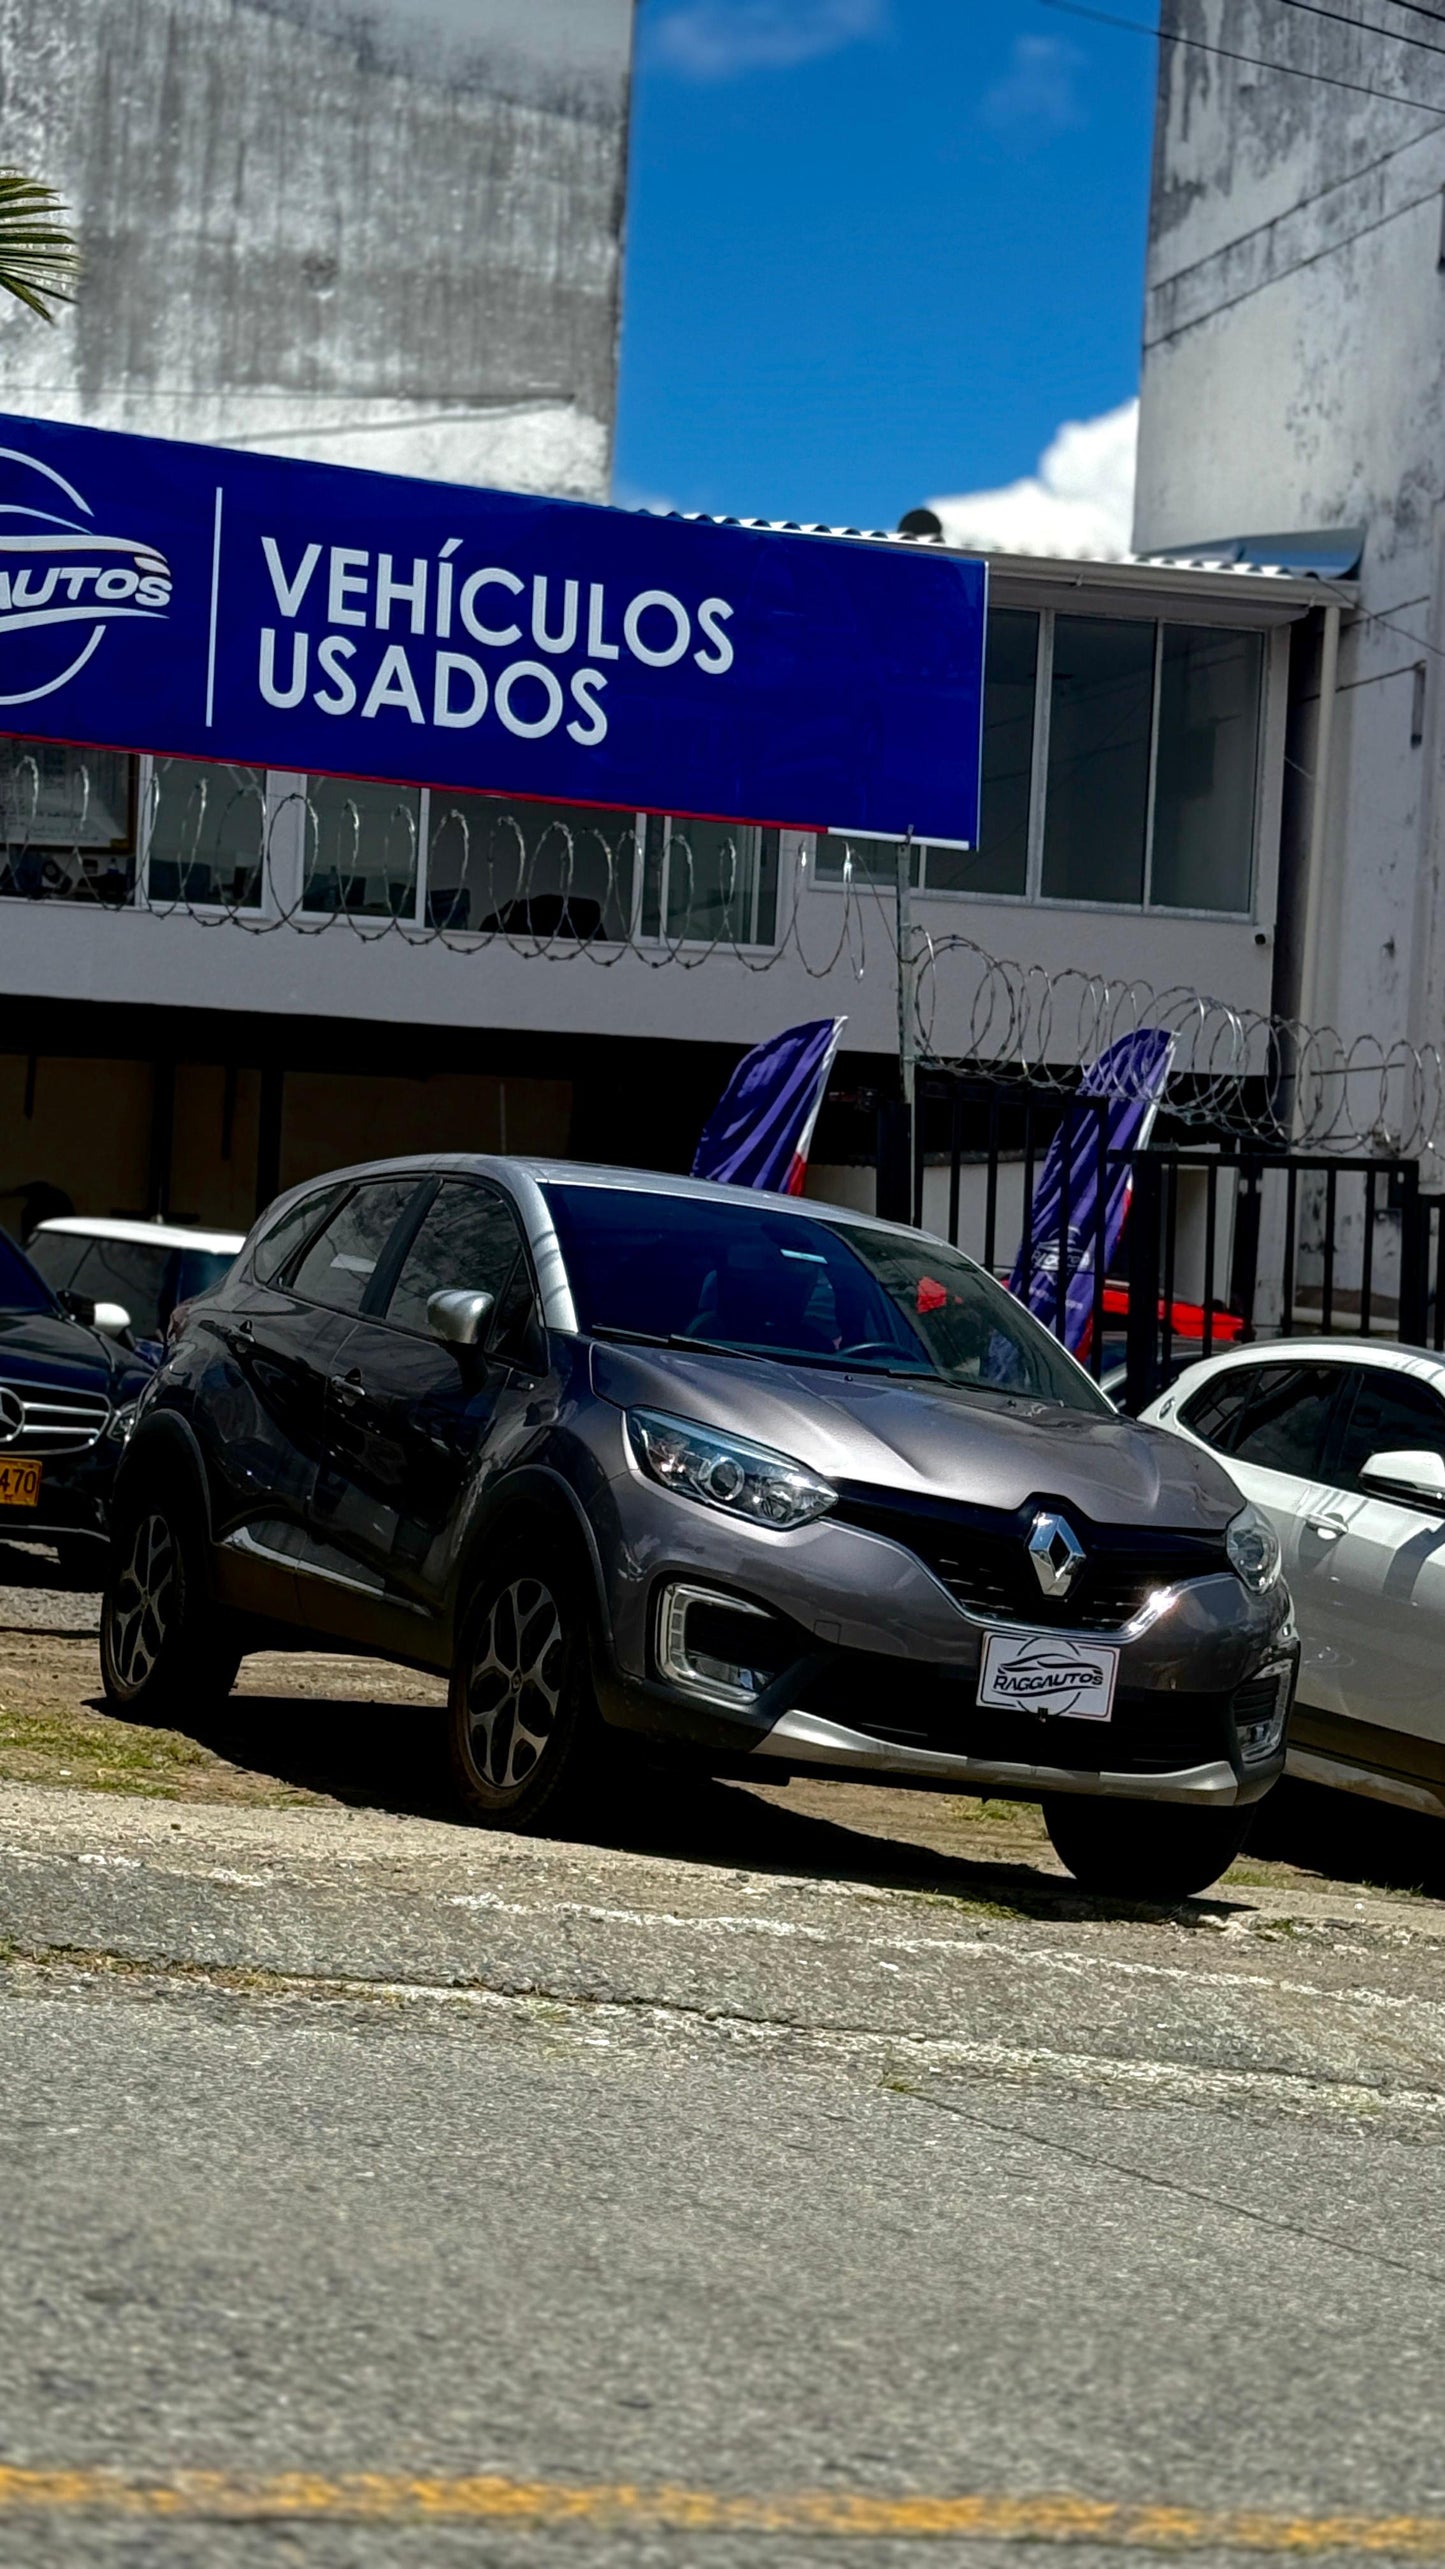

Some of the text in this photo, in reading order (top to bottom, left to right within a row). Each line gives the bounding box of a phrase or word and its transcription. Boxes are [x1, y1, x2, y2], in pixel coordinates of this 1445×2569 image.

[261, 536, 734, 674] VEHÍCULOS
[259, 627, 608, 746] USADOS
[0, 1468, 37, 1494] 470
[993, 1673, 1103, 1691] RAGGAUTOS
